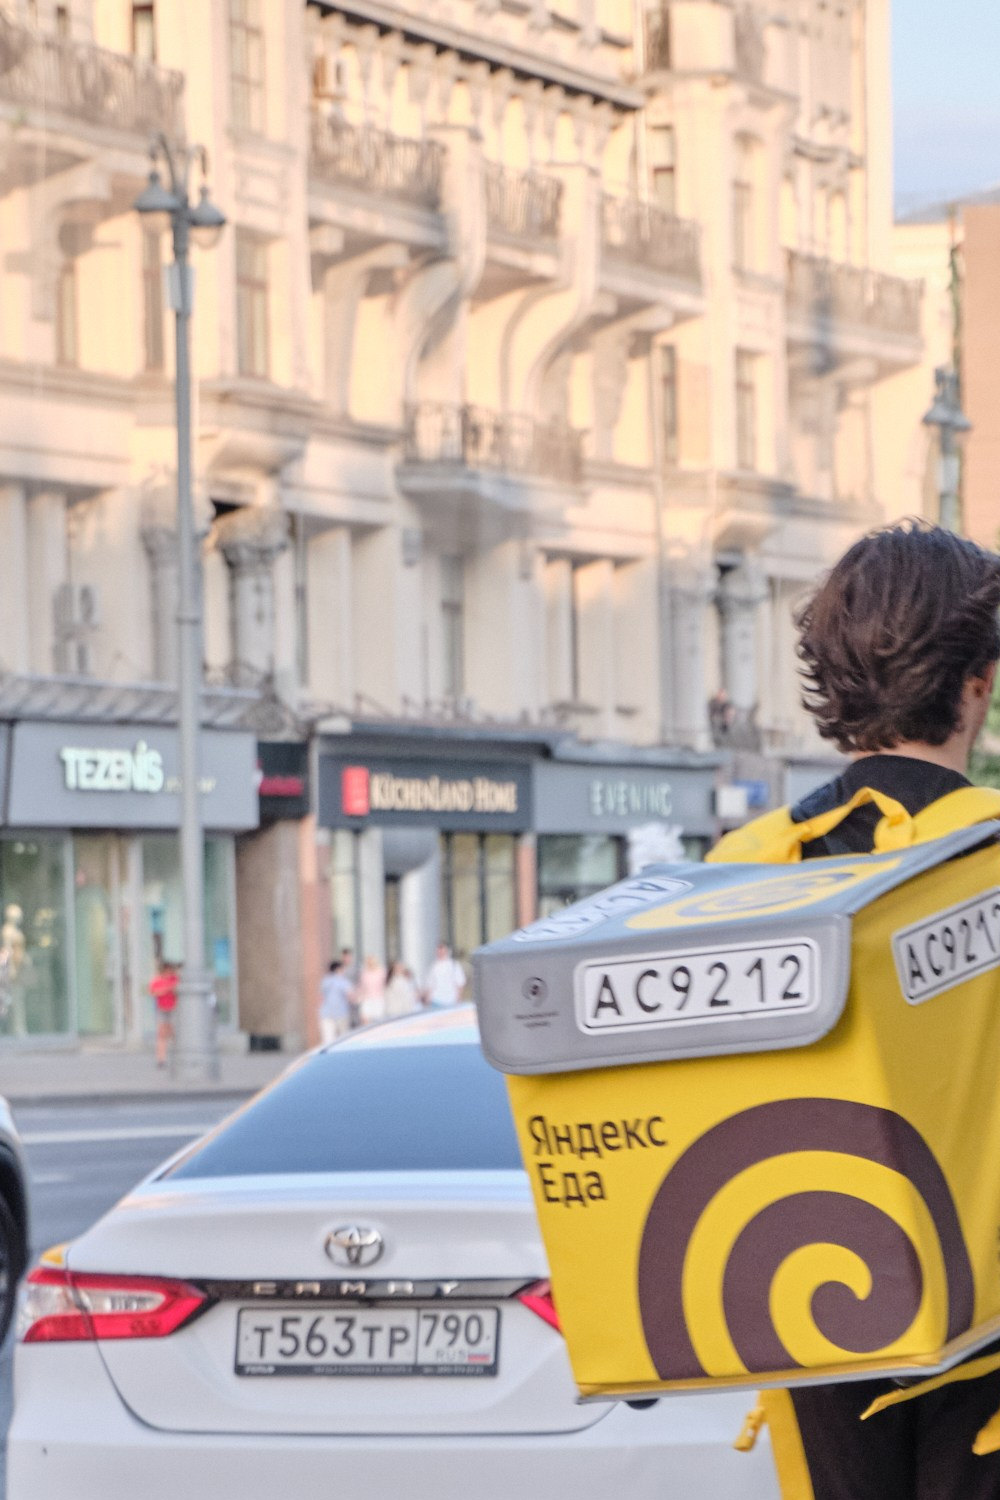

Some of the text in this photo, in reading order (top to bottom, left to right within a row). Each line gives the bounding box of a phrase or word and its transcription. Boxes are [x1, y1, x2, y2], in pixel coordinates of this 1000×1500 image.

[528, 1115, 668, 1160] Яндекс
[537, 1163, 608, 1208] Еда
[253, 1281, 459, 1295] CAMRY
[422, 1314, 484, 1347] 790
